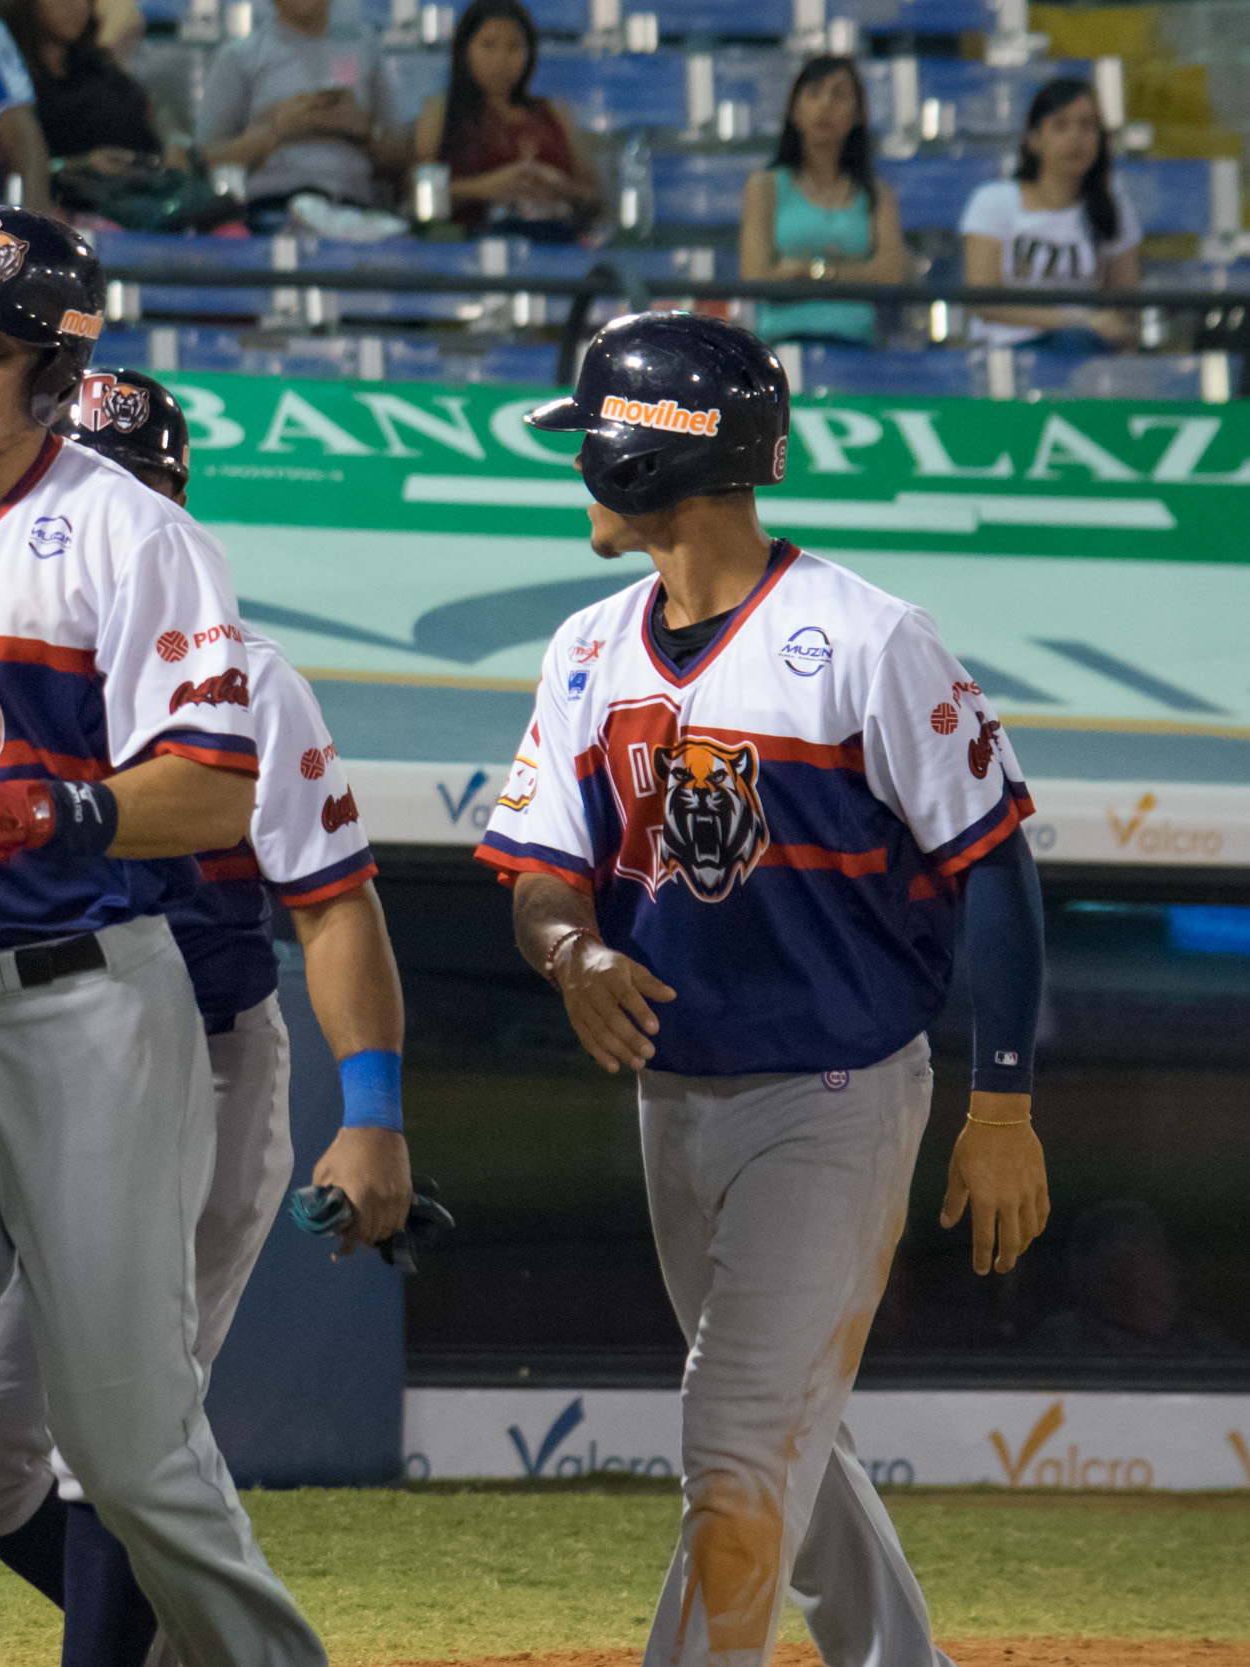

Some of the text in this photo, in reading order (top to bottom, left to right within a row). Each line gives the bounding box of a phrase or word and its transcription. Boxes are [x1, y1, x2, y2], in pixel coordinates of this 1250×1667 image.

[162, 383, 1250, 486] BANC PLAZ
[601, 396, 721, 437] movilnet
[780, 644, 833, 659] MUZIN
[988, 1401, 1153, 1486] Valcro
